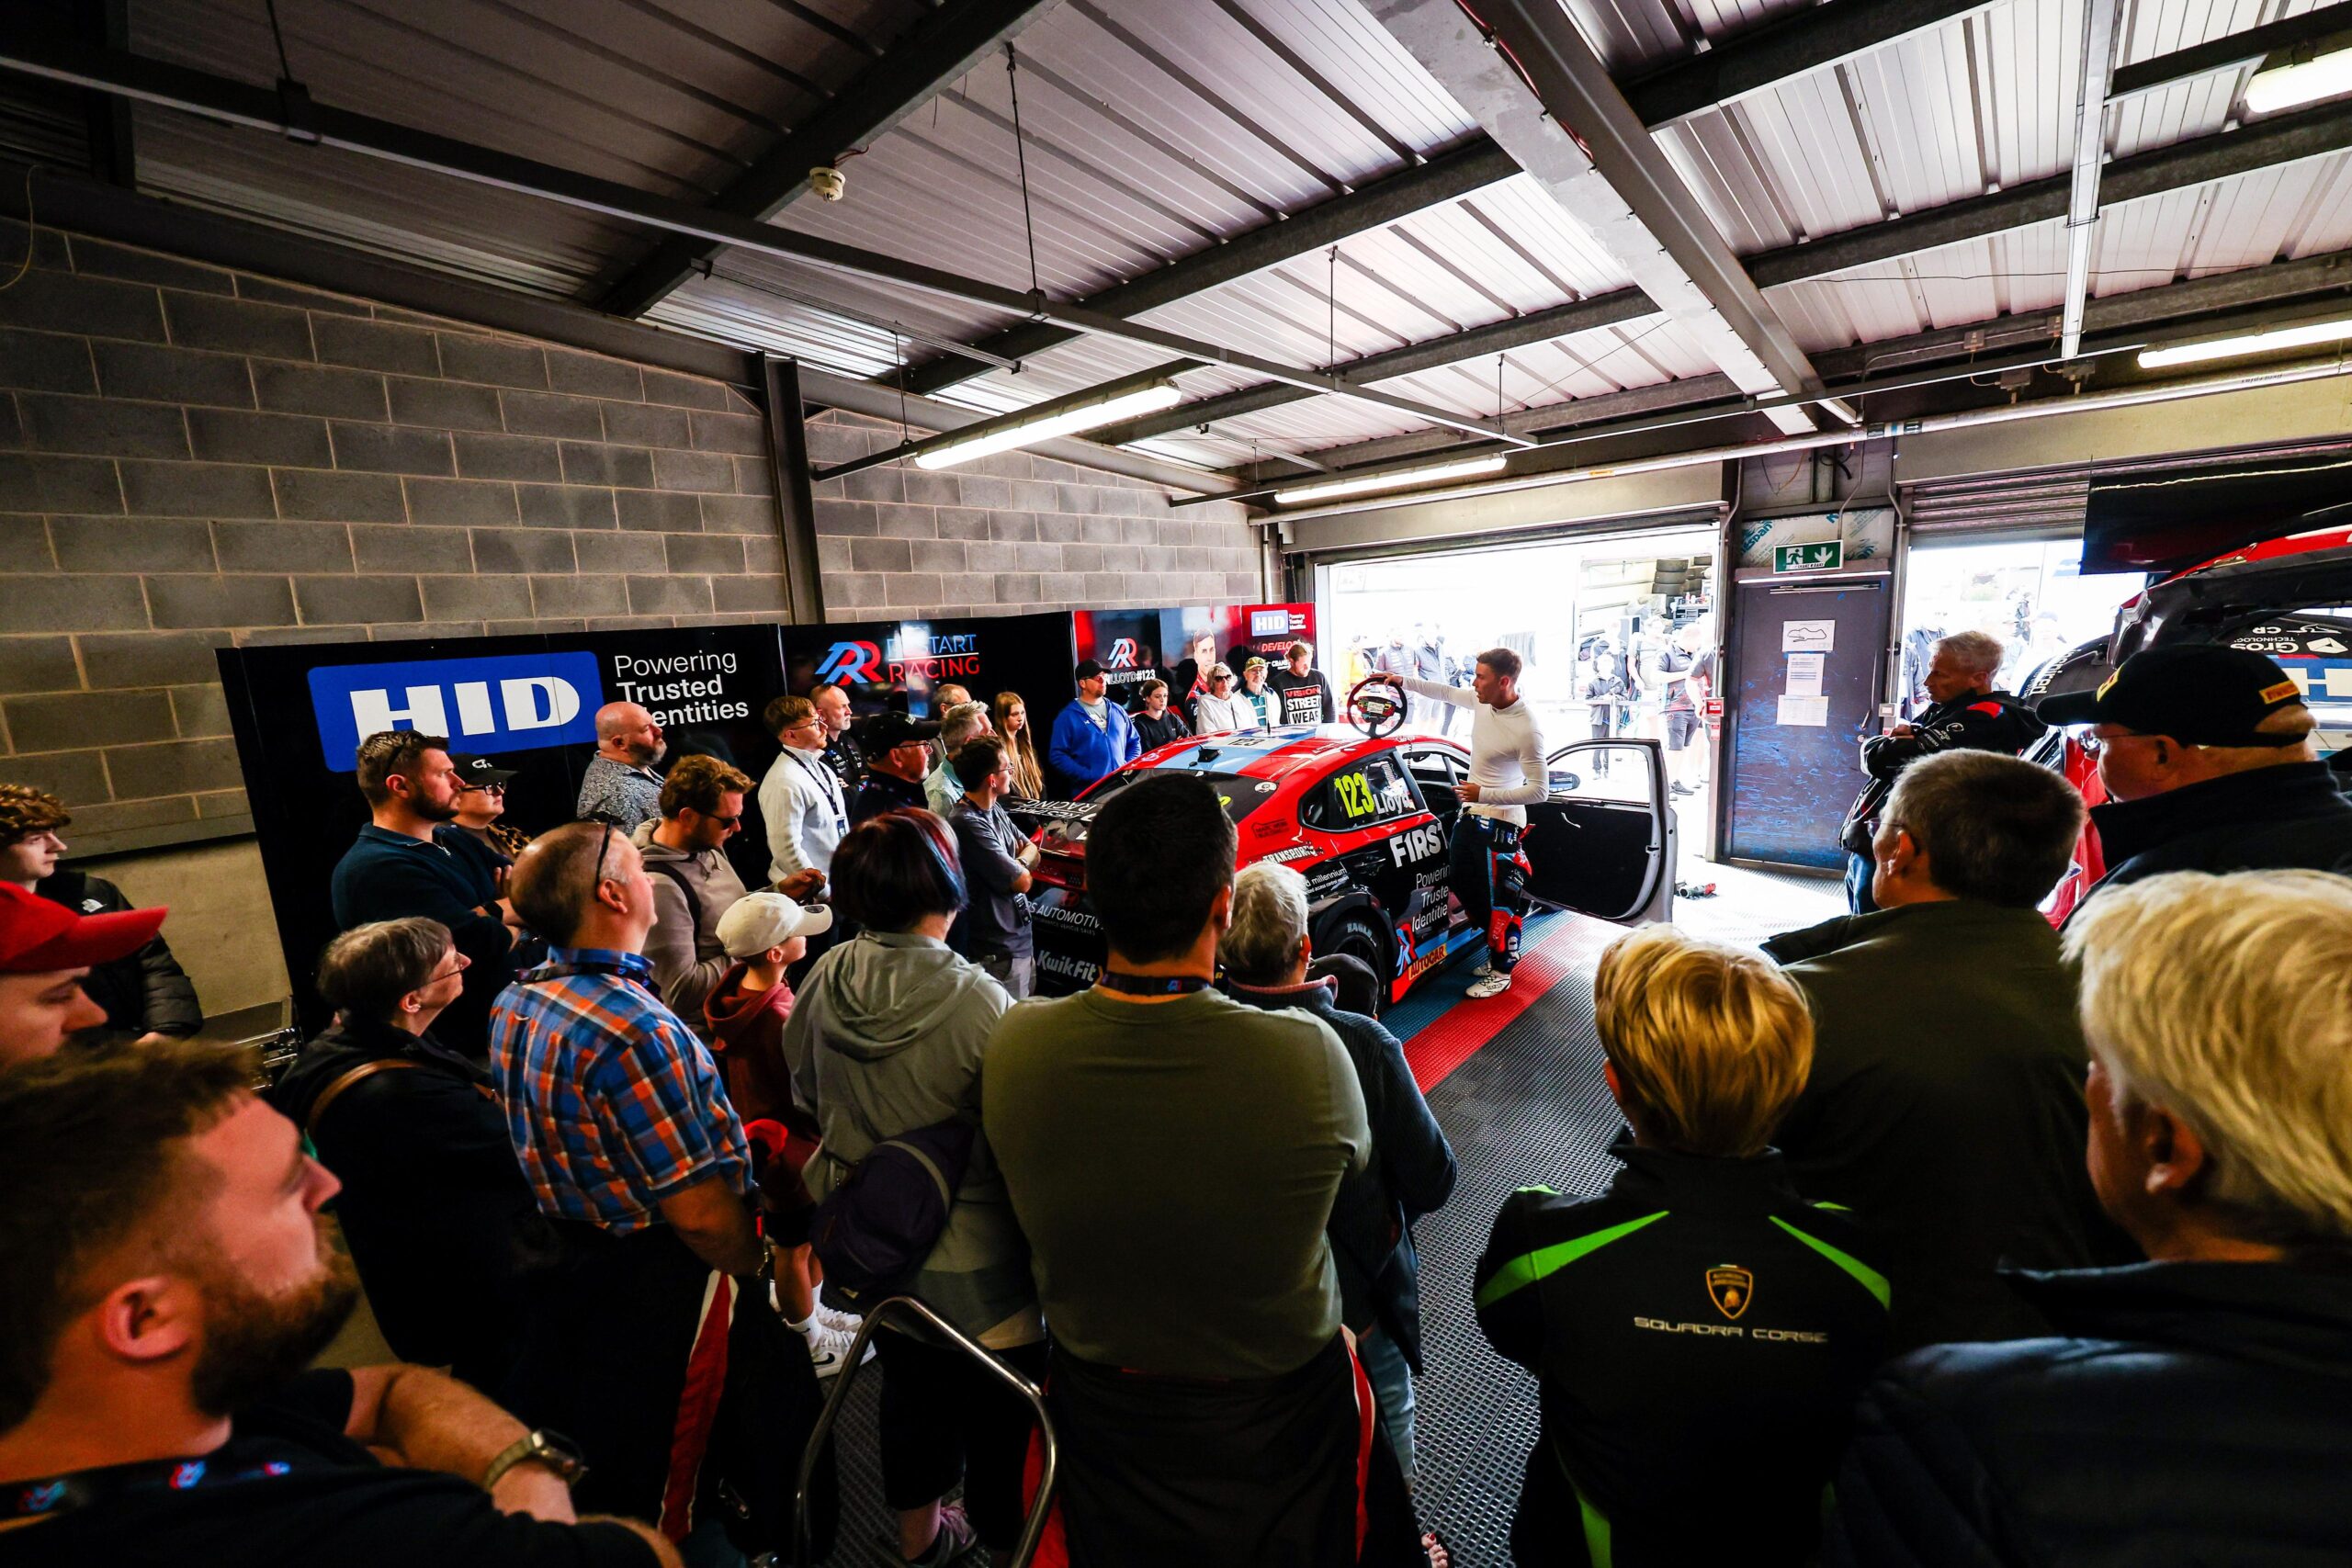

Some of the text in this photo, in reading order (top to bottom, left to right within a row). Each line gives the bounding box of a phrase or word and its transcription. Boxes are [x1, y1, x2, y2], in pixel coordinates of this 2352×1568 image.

[1255, 615, 1285, 632] HID
[614, 649, 738, 678] Powering
[888, 656, 980, 683] RACING
[616, 673, 724, 704] Trusted
[1286, 685, 1321, 697] VISION
[349, 675, 581, 746] HID
[643, 699, 750, 728] entities
[1287, 696, 1321, 711] STREET
[1023, 799, 1097, 813] RACING
[1334, 773, 1375, 818] 123
[1373, 792, 1410, 816] Lloyd
[1389, 822, 1443, 868] F1RS
[1311, 867, 1348, 885] millennium
[1416, 863, 1450, 889] Powerin
[1421, 885, 1449, 908] Truste
[1036, 905, 1103, 930] AUTOMOTIV
[1411, 903, 1448, 932] Identitie
[1409, 944, 1445, 978] AUTOCAR
[1634, 1315, 1829, 1344] SQUADRA CORSE
